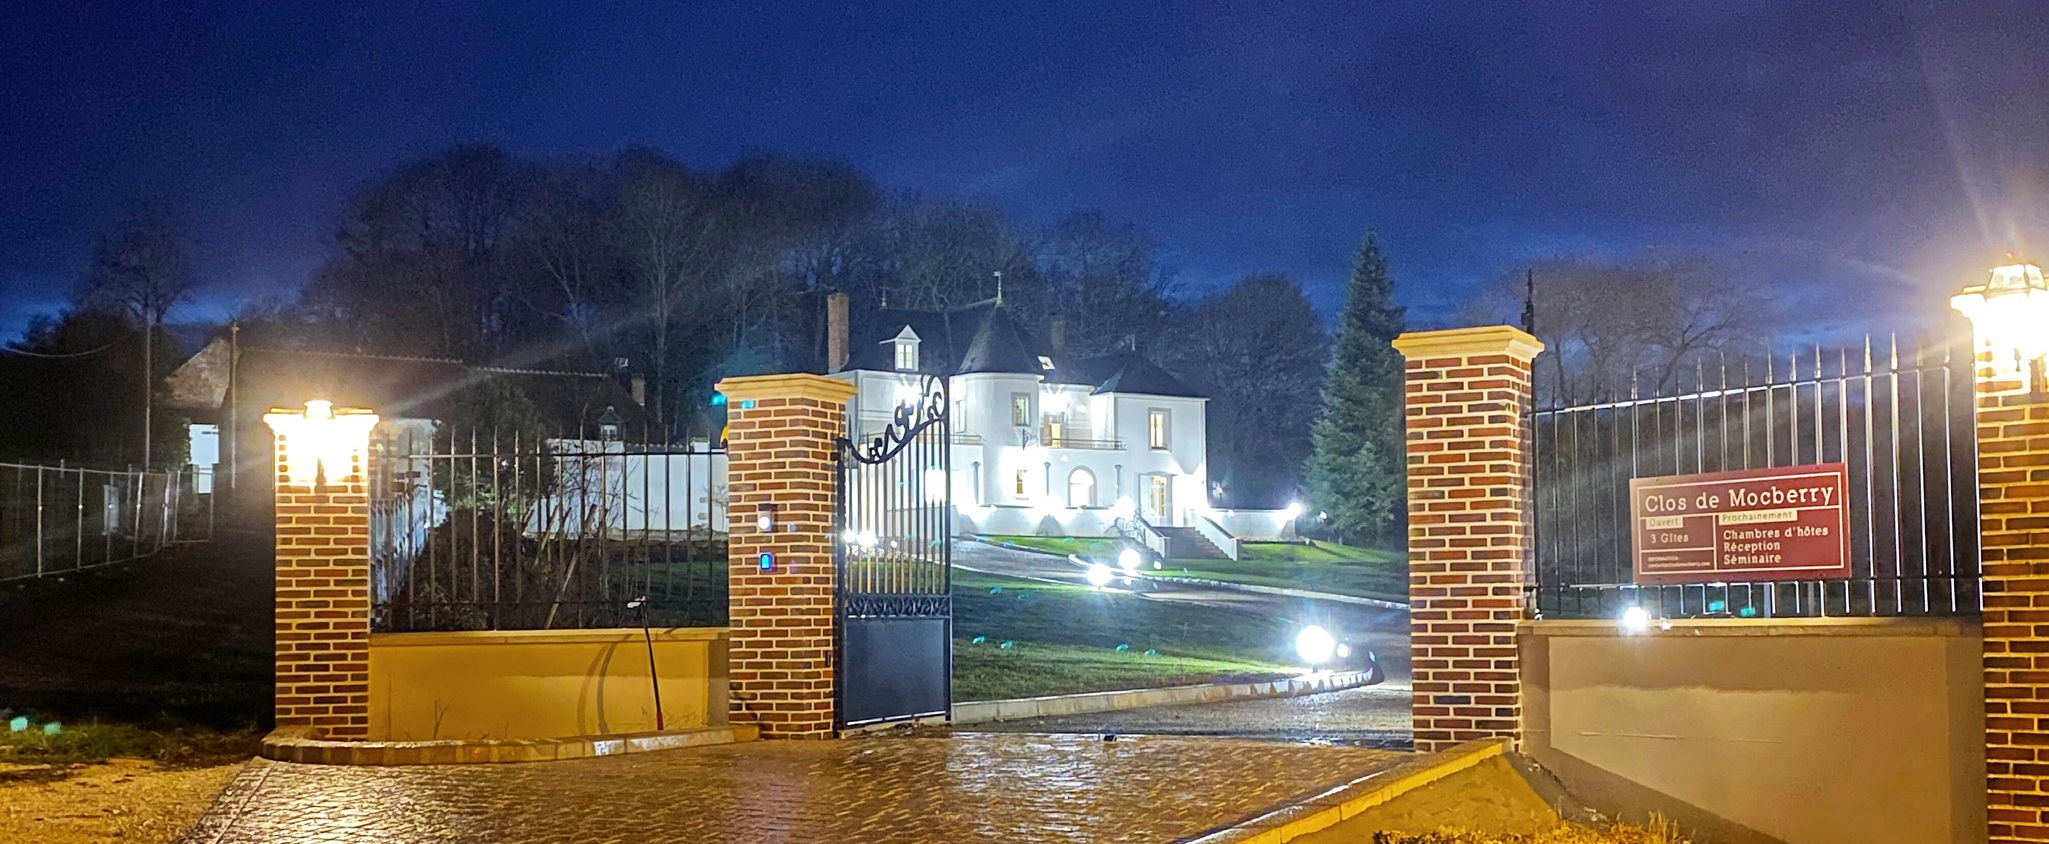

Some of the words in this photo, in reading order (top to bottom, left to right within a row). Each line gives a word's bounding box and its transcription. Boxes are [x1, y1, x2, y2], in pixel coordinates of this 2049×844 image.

[1645, 495, 1687, 512] Clos
[1696, 492, 1719, 509] de
[1728, 485, 1834, 507] Mocberry
[1649, 517, 1680, 527] Ouvert
[1721, 511, 1793, 523] Prochainement
[1723, 527, 1781, 540] Chambres
[1784, 524, 1829, 538] d'hôtes
[1650, 533, 1656, 544] 3
[1723, 540, 1781, 554] Réception
[1723, 553, 1782, 565] Séminaire
